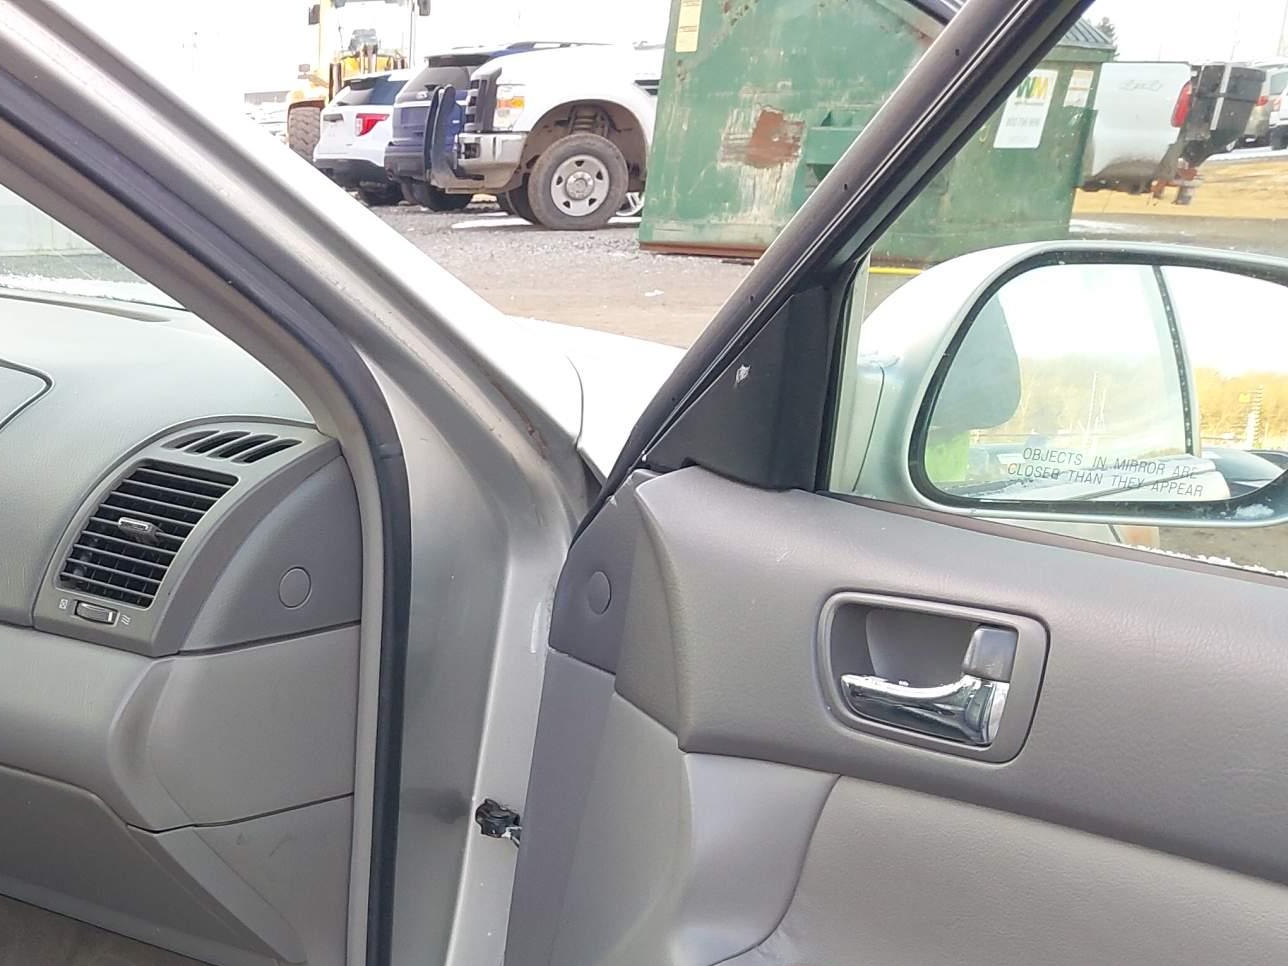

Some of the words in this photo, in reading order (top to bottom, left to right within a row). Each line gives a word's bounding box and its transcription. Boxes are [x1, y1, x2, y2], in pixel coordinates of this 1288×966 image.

[1007, 463, 1061, 480] CLOSER
[1068, 470, 1103, 486] THAN
[1111, 475, 1145, 489] THEY
[1151, 481, 1204, 497] APPEAR
[1023, 447, 1083, 466] OBJECTS
[1092, 456, 1107, 470] IN
[1113, 458, 1165, 476] MIRROR
[1172, 466, 1198, 480] ARE
